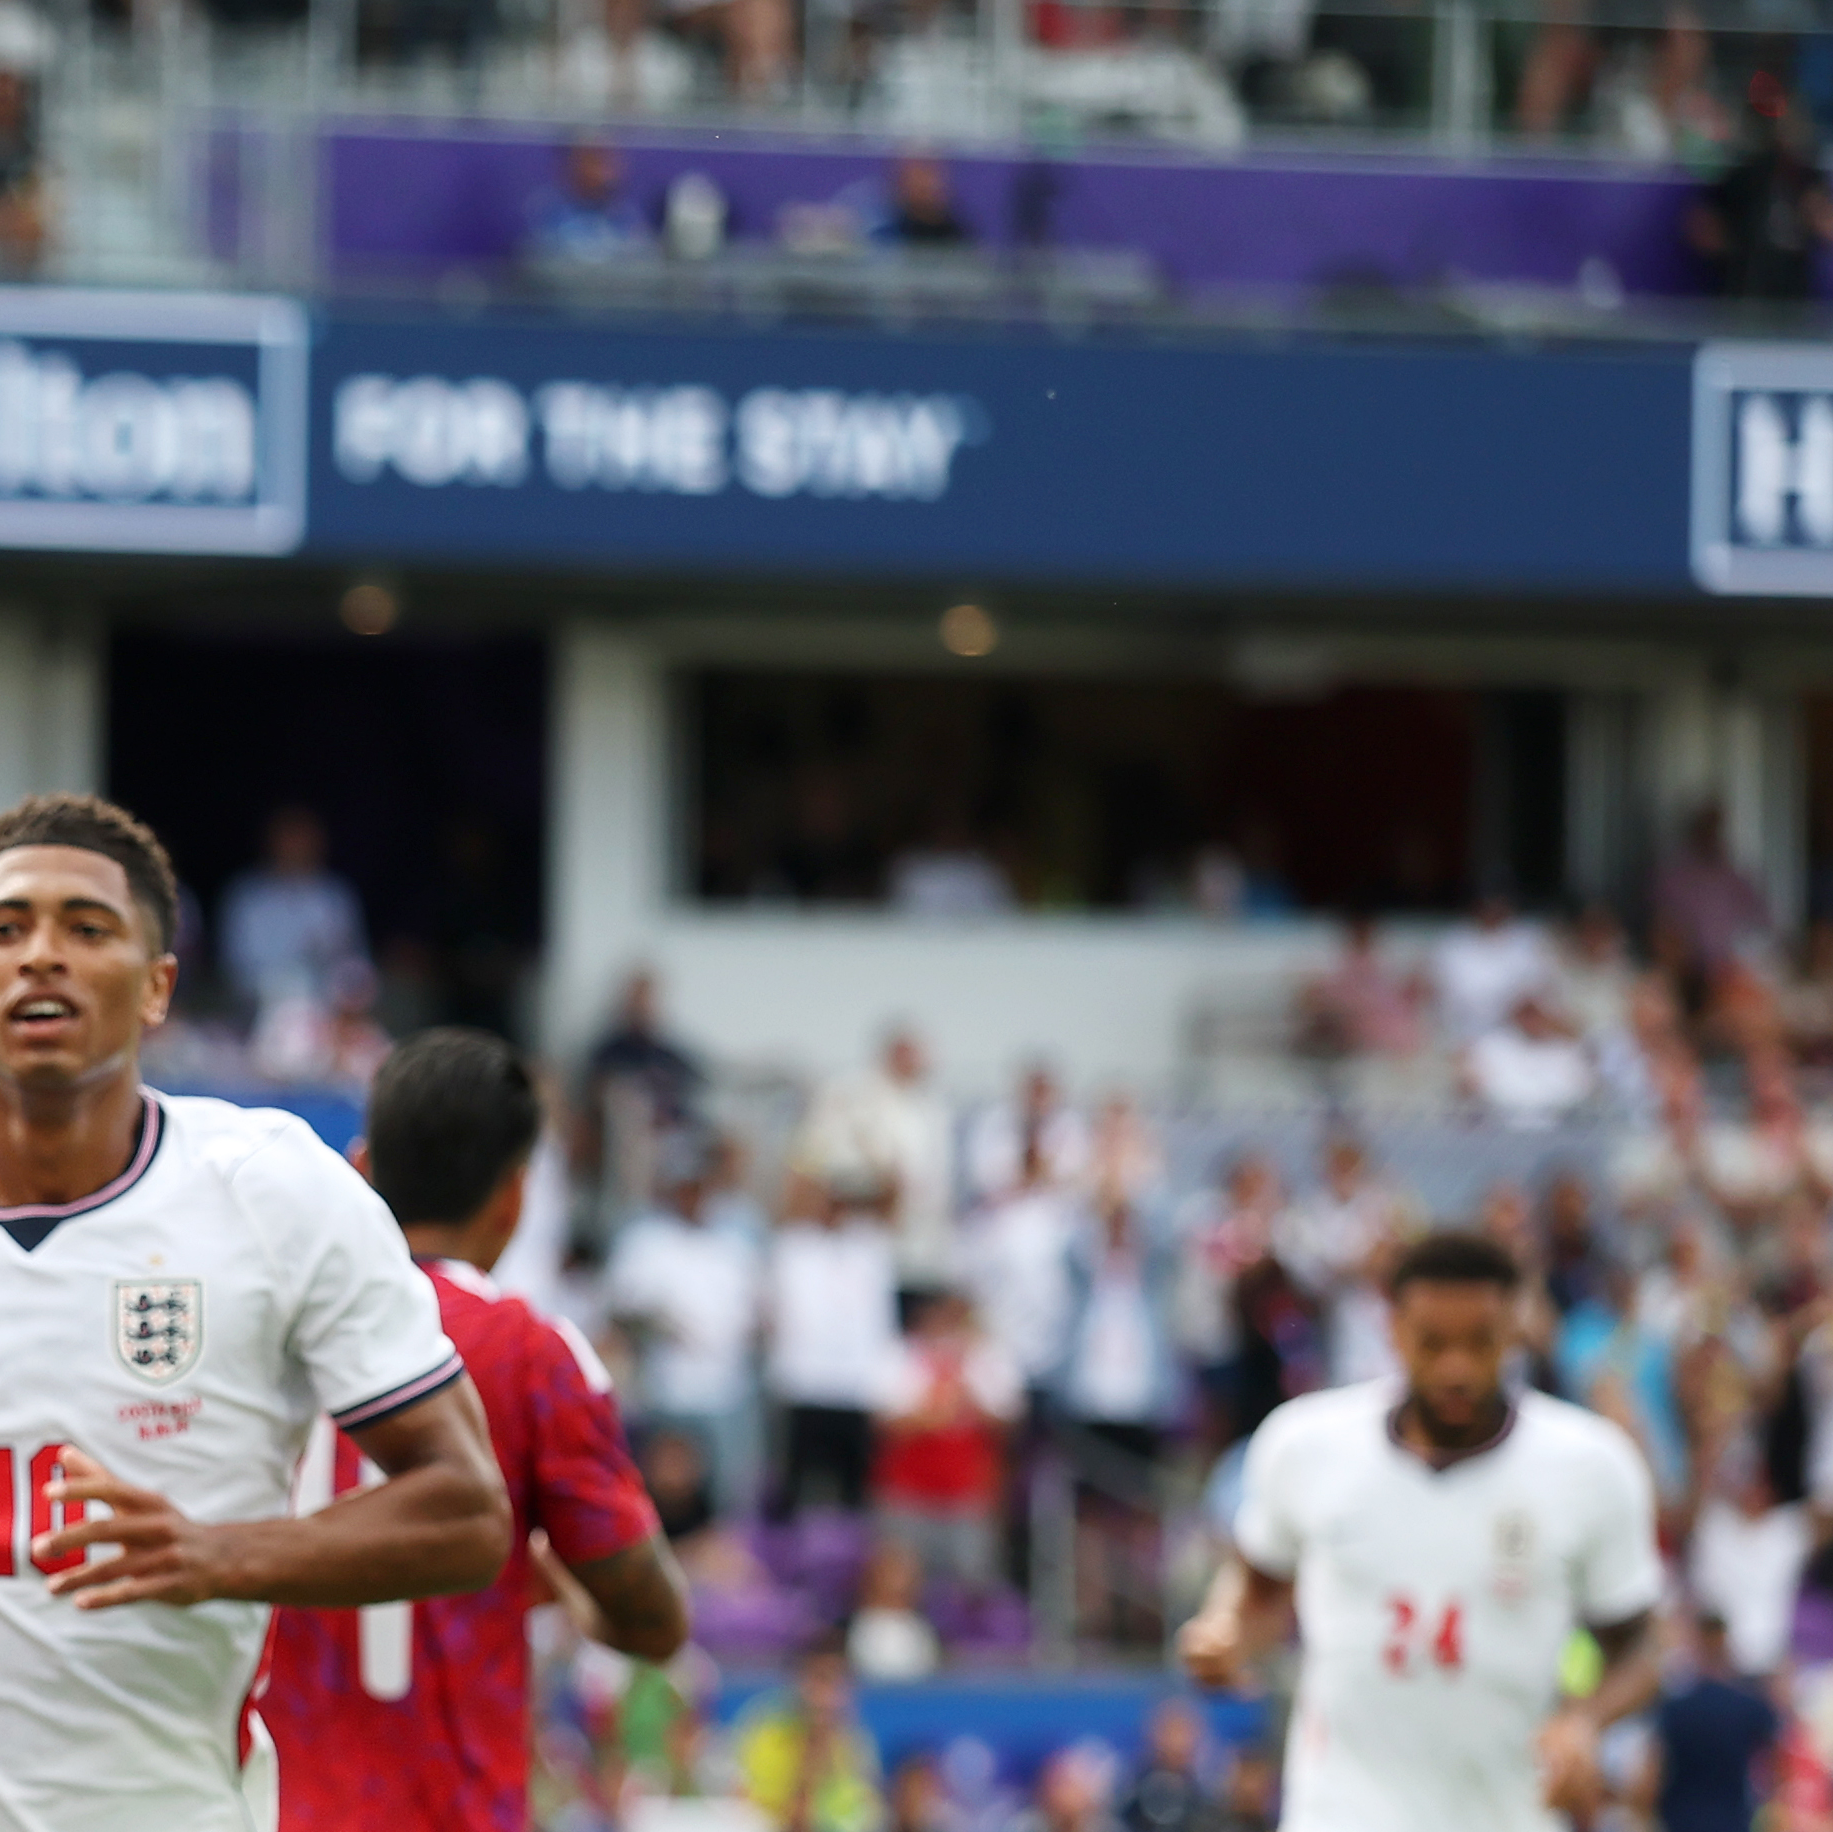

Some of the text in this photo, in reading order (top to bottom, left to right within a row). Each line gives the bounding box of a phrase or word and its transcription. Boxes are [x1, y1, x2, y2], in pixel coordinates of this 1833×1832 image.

[335, 373, 527, 488] FOR
[536, 379, 730, 495] THE
[1380, 1590, 1465, 1677] 24
